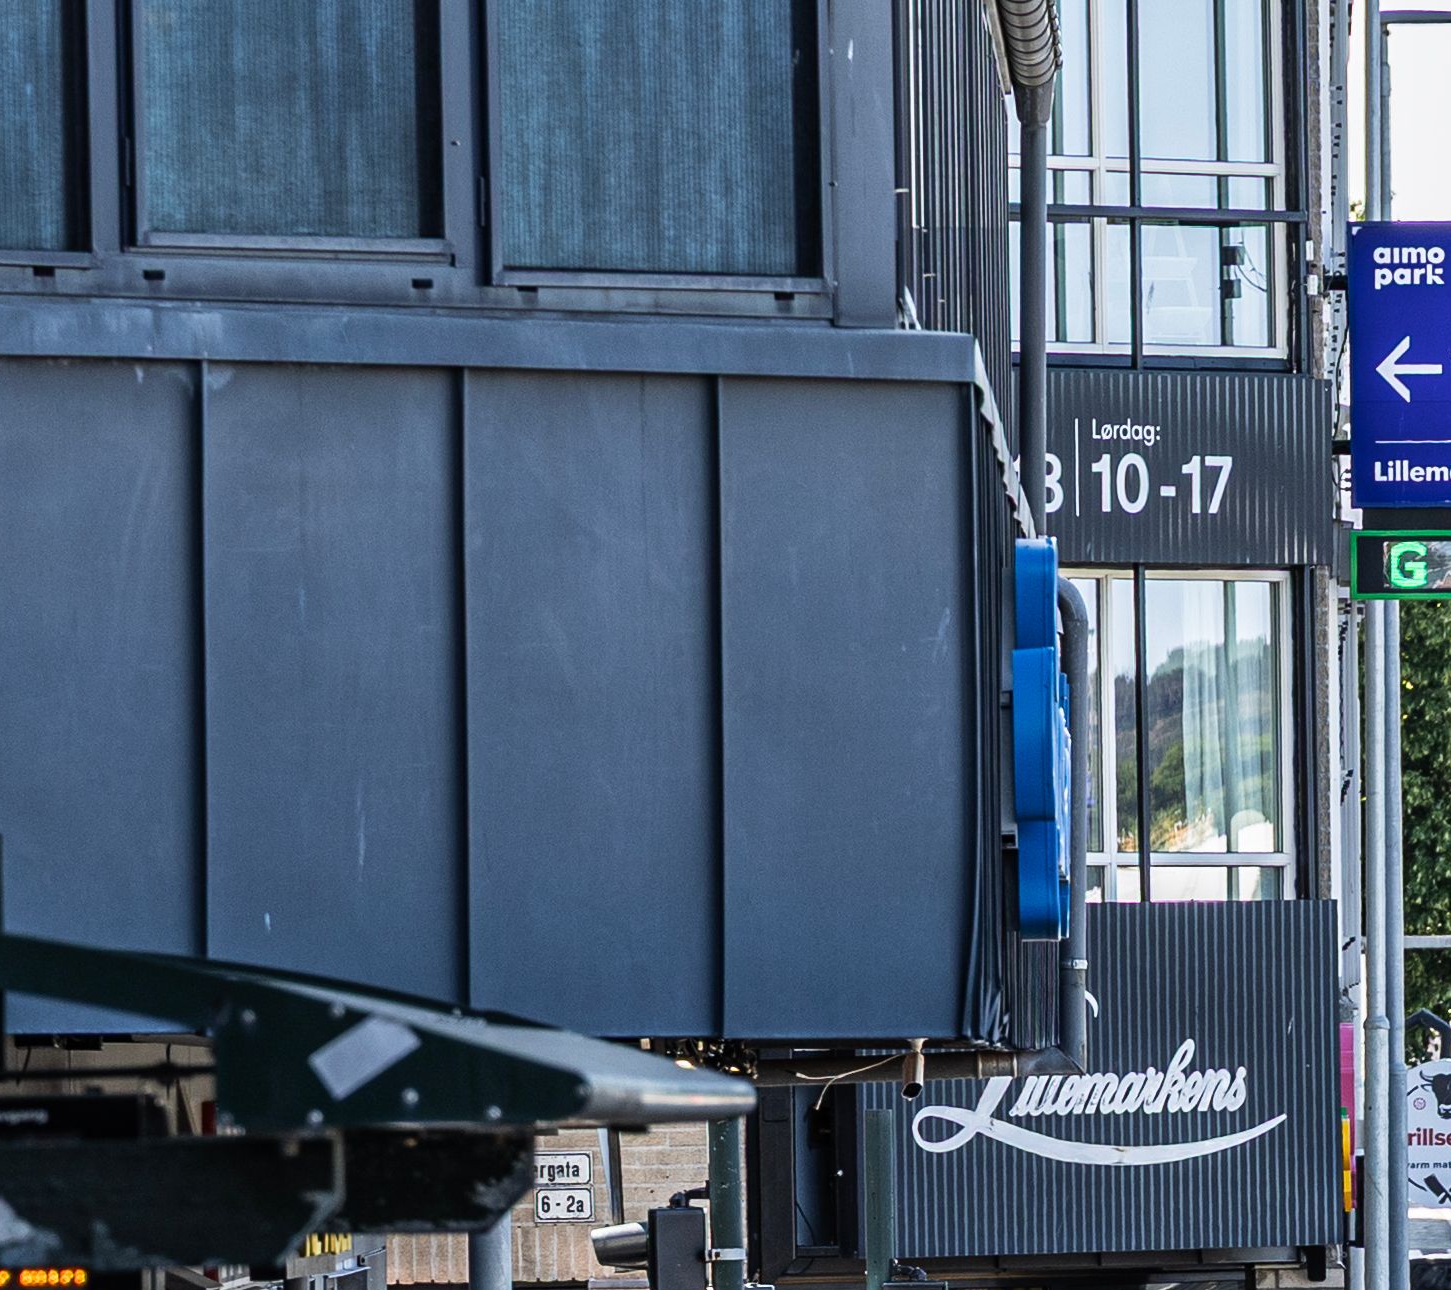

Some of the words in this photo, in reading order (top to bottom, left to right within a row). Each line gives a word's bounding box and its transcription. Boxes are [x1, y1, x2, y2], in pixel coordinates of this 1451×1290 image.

[1373, 246, 1445, 264] aimo
[1374, 267, 1445, 289] park
[1092, 418, 1161, 446] Lørdag:
[1433, 1161, 1451, 1169] mat
